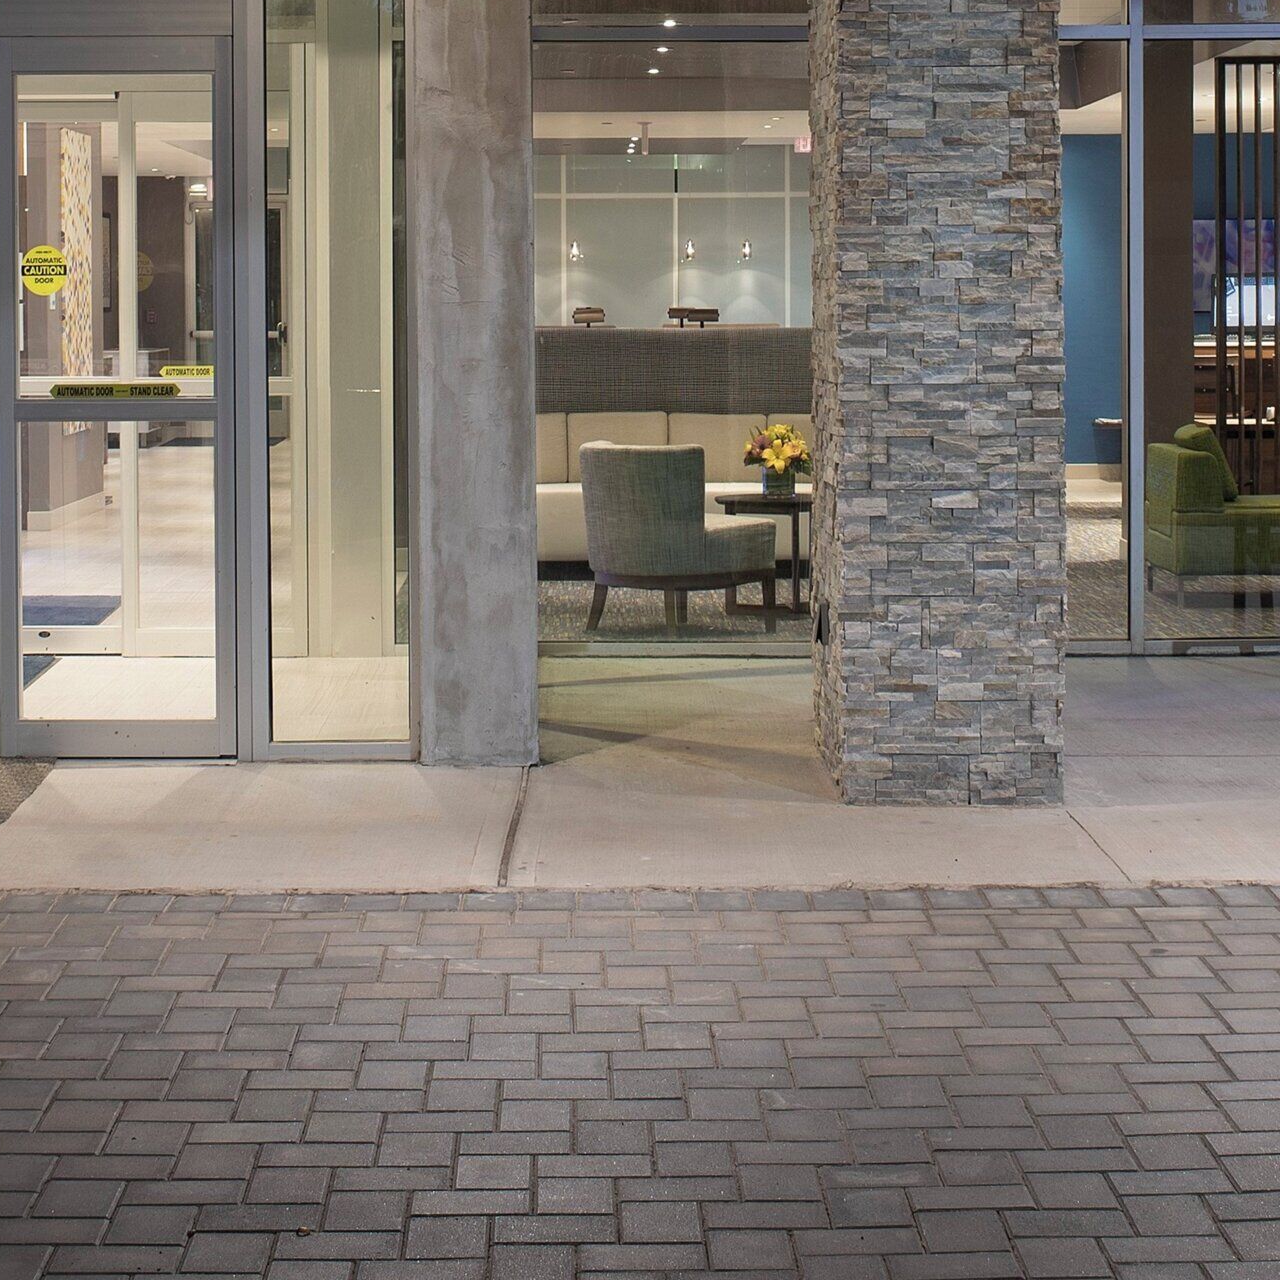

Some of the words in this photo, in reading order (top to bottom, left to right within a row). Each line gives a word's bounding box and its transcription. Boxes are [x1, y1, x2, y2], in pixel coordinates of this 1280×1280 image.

[24, 266, 64, 275] CAUTION
[165, 368, 194, 376] AUTOMATIC
[195, 368, 210, 376] DOOR
[57, 387, 94, 396] AUTOMATIC
[95, 387, 114, 396] DOOR
[130, 387, 151, 396] STAND
[152, 387, 174, 396] CLEAR
